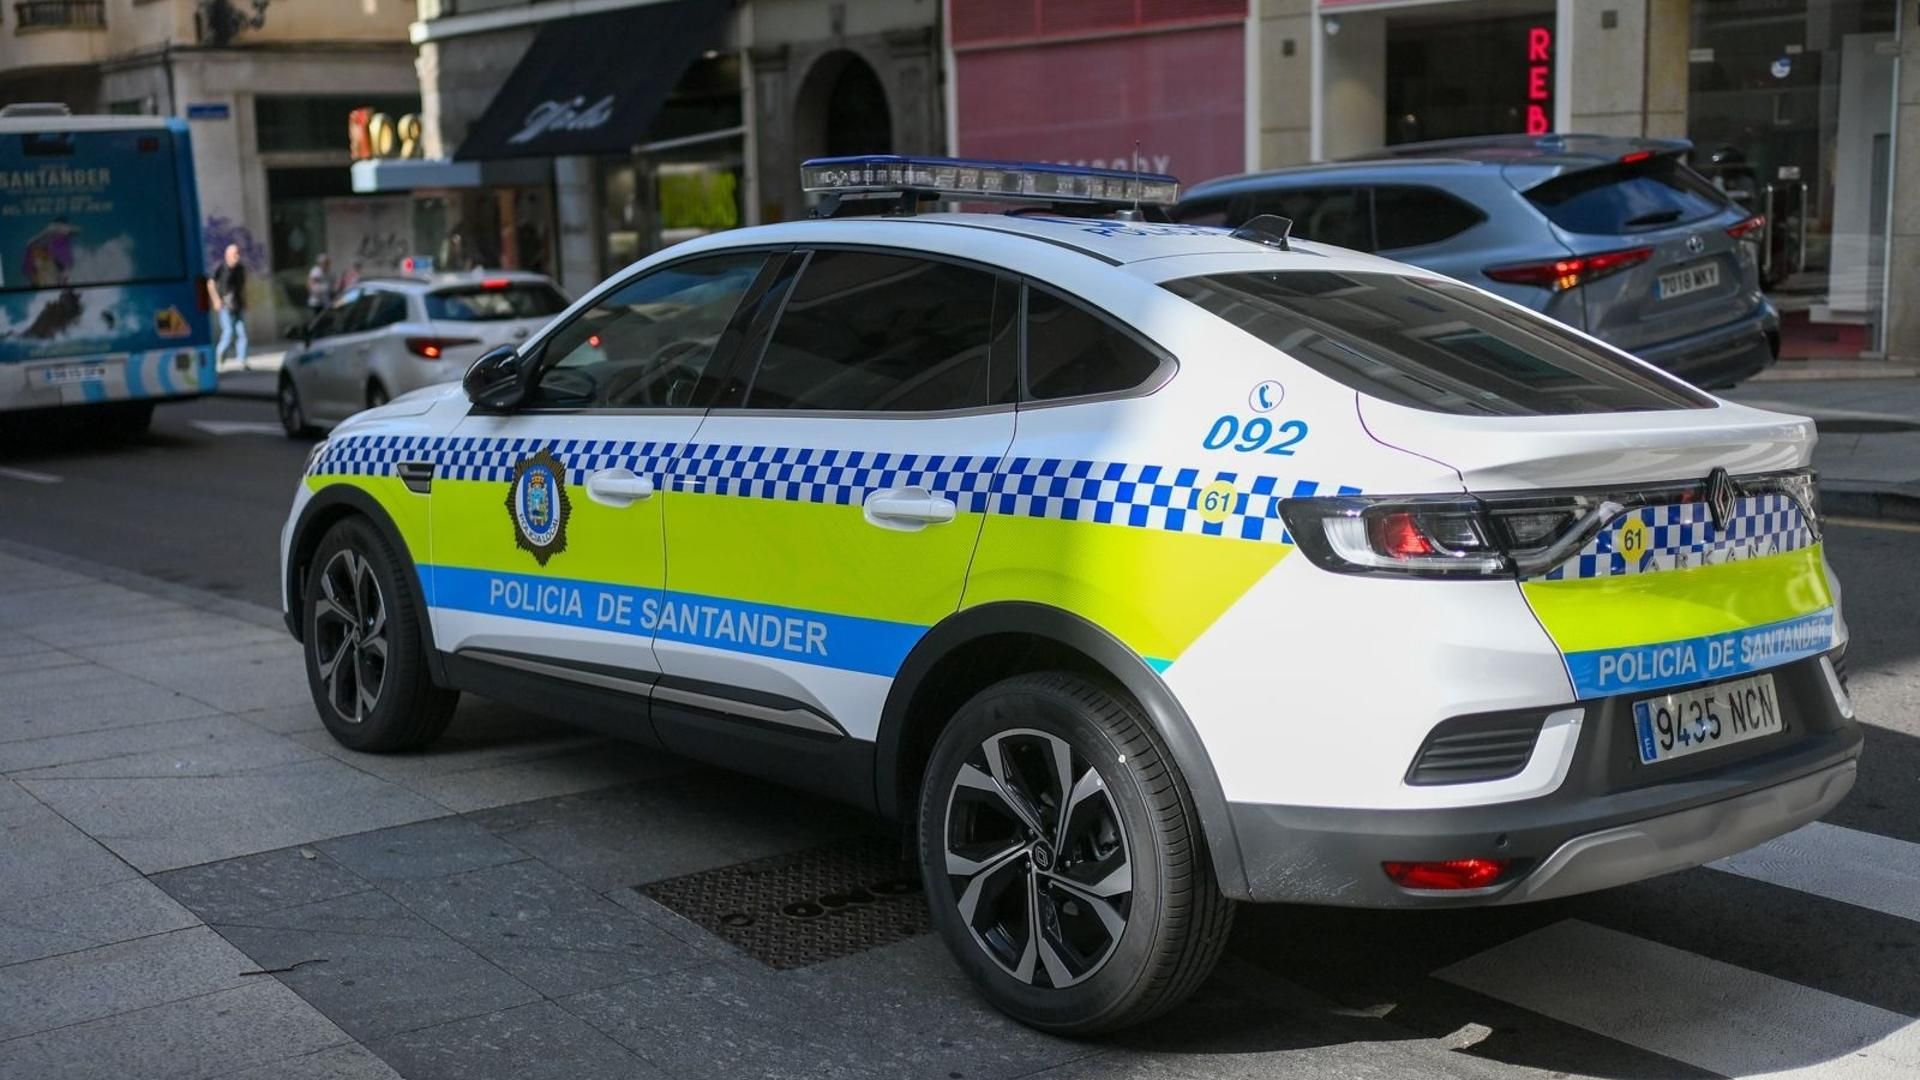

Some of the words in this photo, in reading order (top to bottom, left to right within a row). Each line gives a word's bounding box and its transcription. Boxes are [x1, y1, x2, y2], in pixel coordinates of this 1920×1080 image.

[1662, 271, 1692, 295] 7018
[1203, 415, 1308, 456] 092
[1204, 491, 1230, 512] 61
[1624, 528, 1642, 551] 61
[1643, 541, 1780, 573] ARKANA
[490, 578, 584, 618] POLICIA
[596, 593, 633, 626] DE
[640, 598, 828, 656] SANTANDER
[1599, 648, 1697, 687] POLICIA
[1708, 639, 1735, 671] DE
[1740, 618, 1827, 663] SANTANDER
[1656, 697, 1722, 751] 9435
[1728, 685, 1776, 734] NCN
